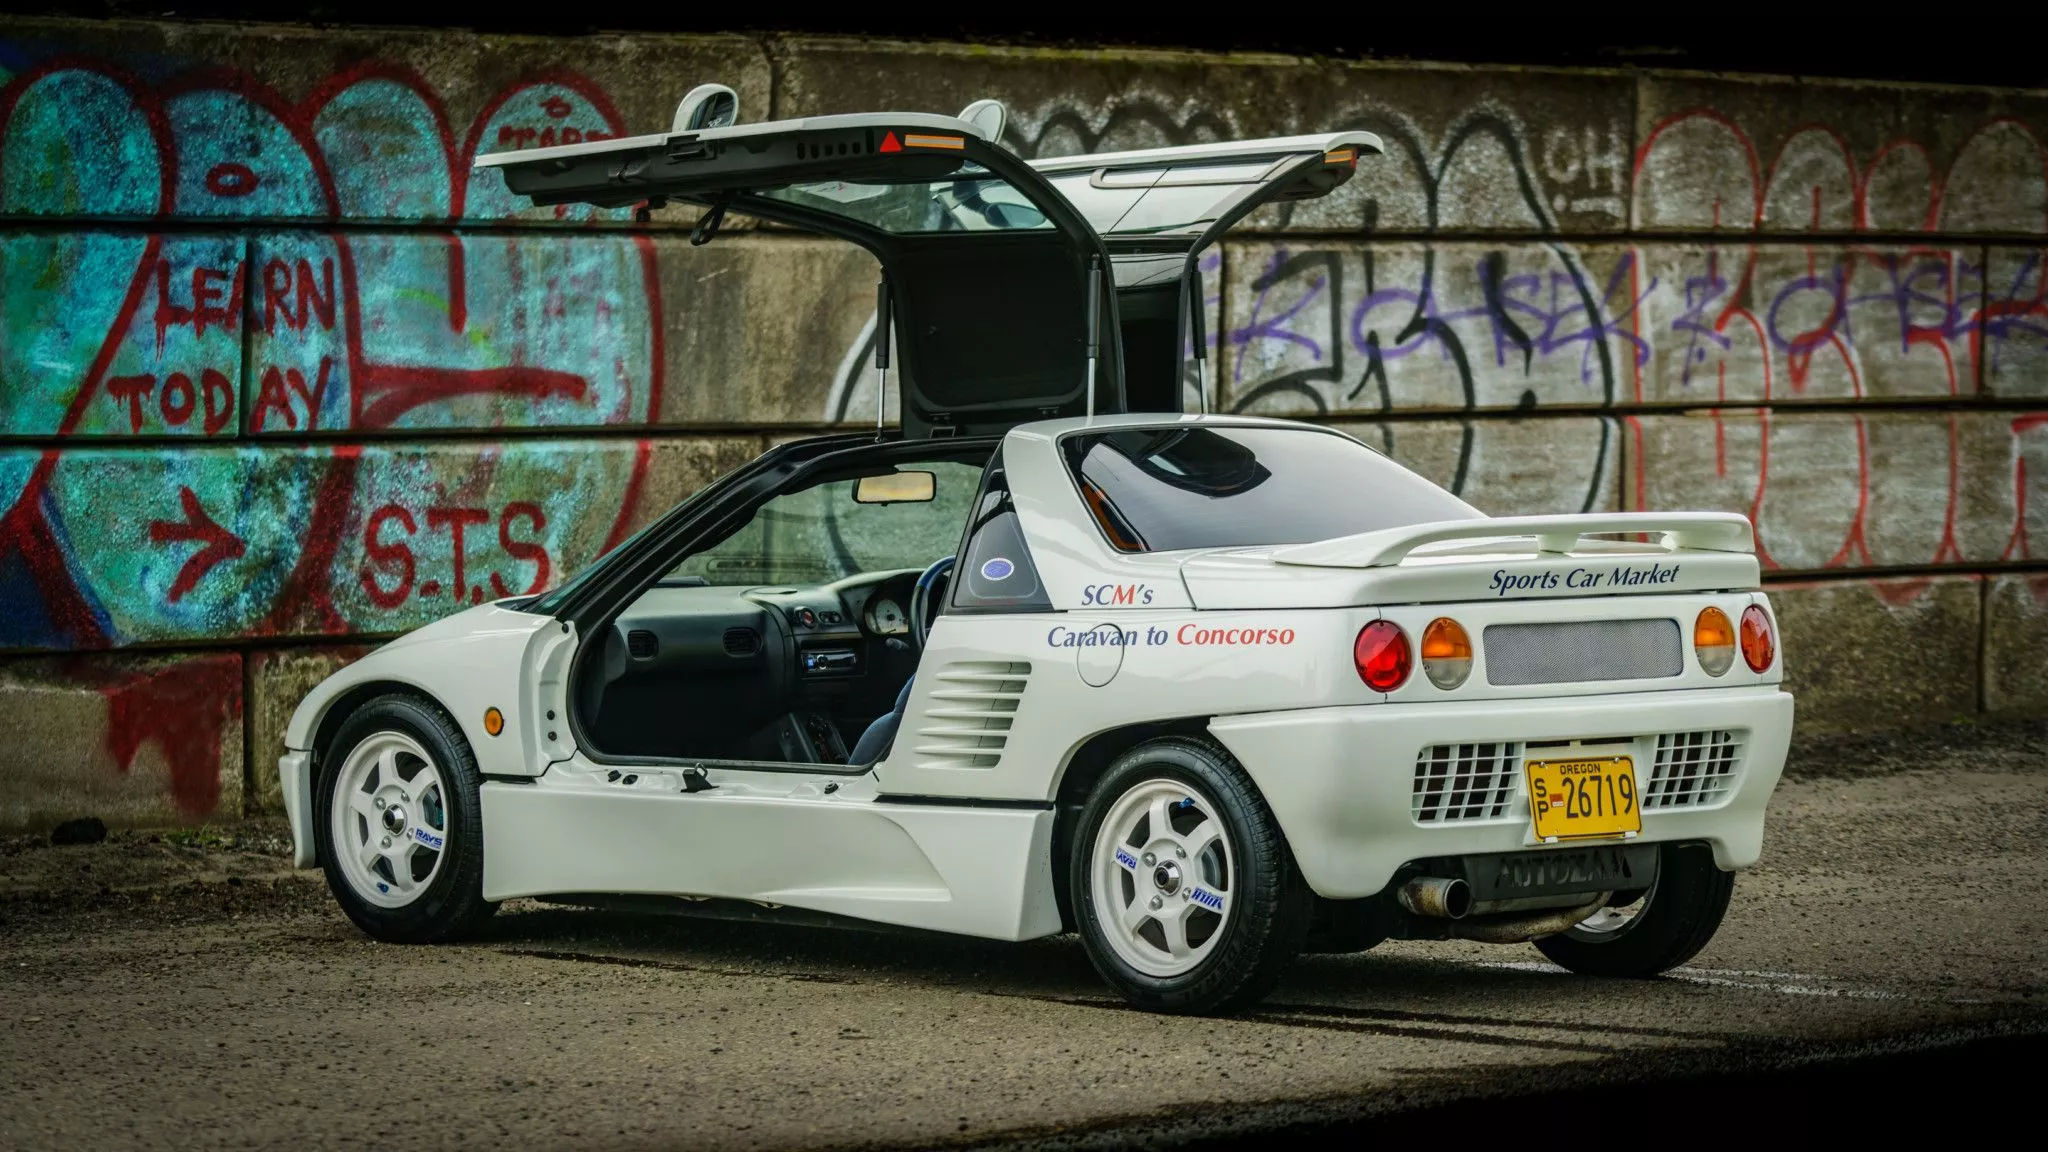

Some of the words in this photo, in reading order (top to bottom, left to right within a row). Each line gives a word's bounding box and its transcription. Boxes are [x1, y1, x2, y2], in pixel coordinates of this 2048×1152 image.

[152, 256, 337, 345] LEARN
[106, 356, 334, 437] TODAY
[1489, 569, 1560, 596] Sports
[1566, 568, 1604, 588] Car
[1607, 563, 1681, 587] Market
[1081, 584, 1154, 606] SCM's
[1047, 626, 1138, 648] Caravan
[1146, 626, 1168, 646] to
[1176, 624, 1295, 646] Concorso
[1560, 763, 1601, 775] OREGON
[1561, 773, 1633, 819] 26719
[415, 828, 443, 846] RAYS
